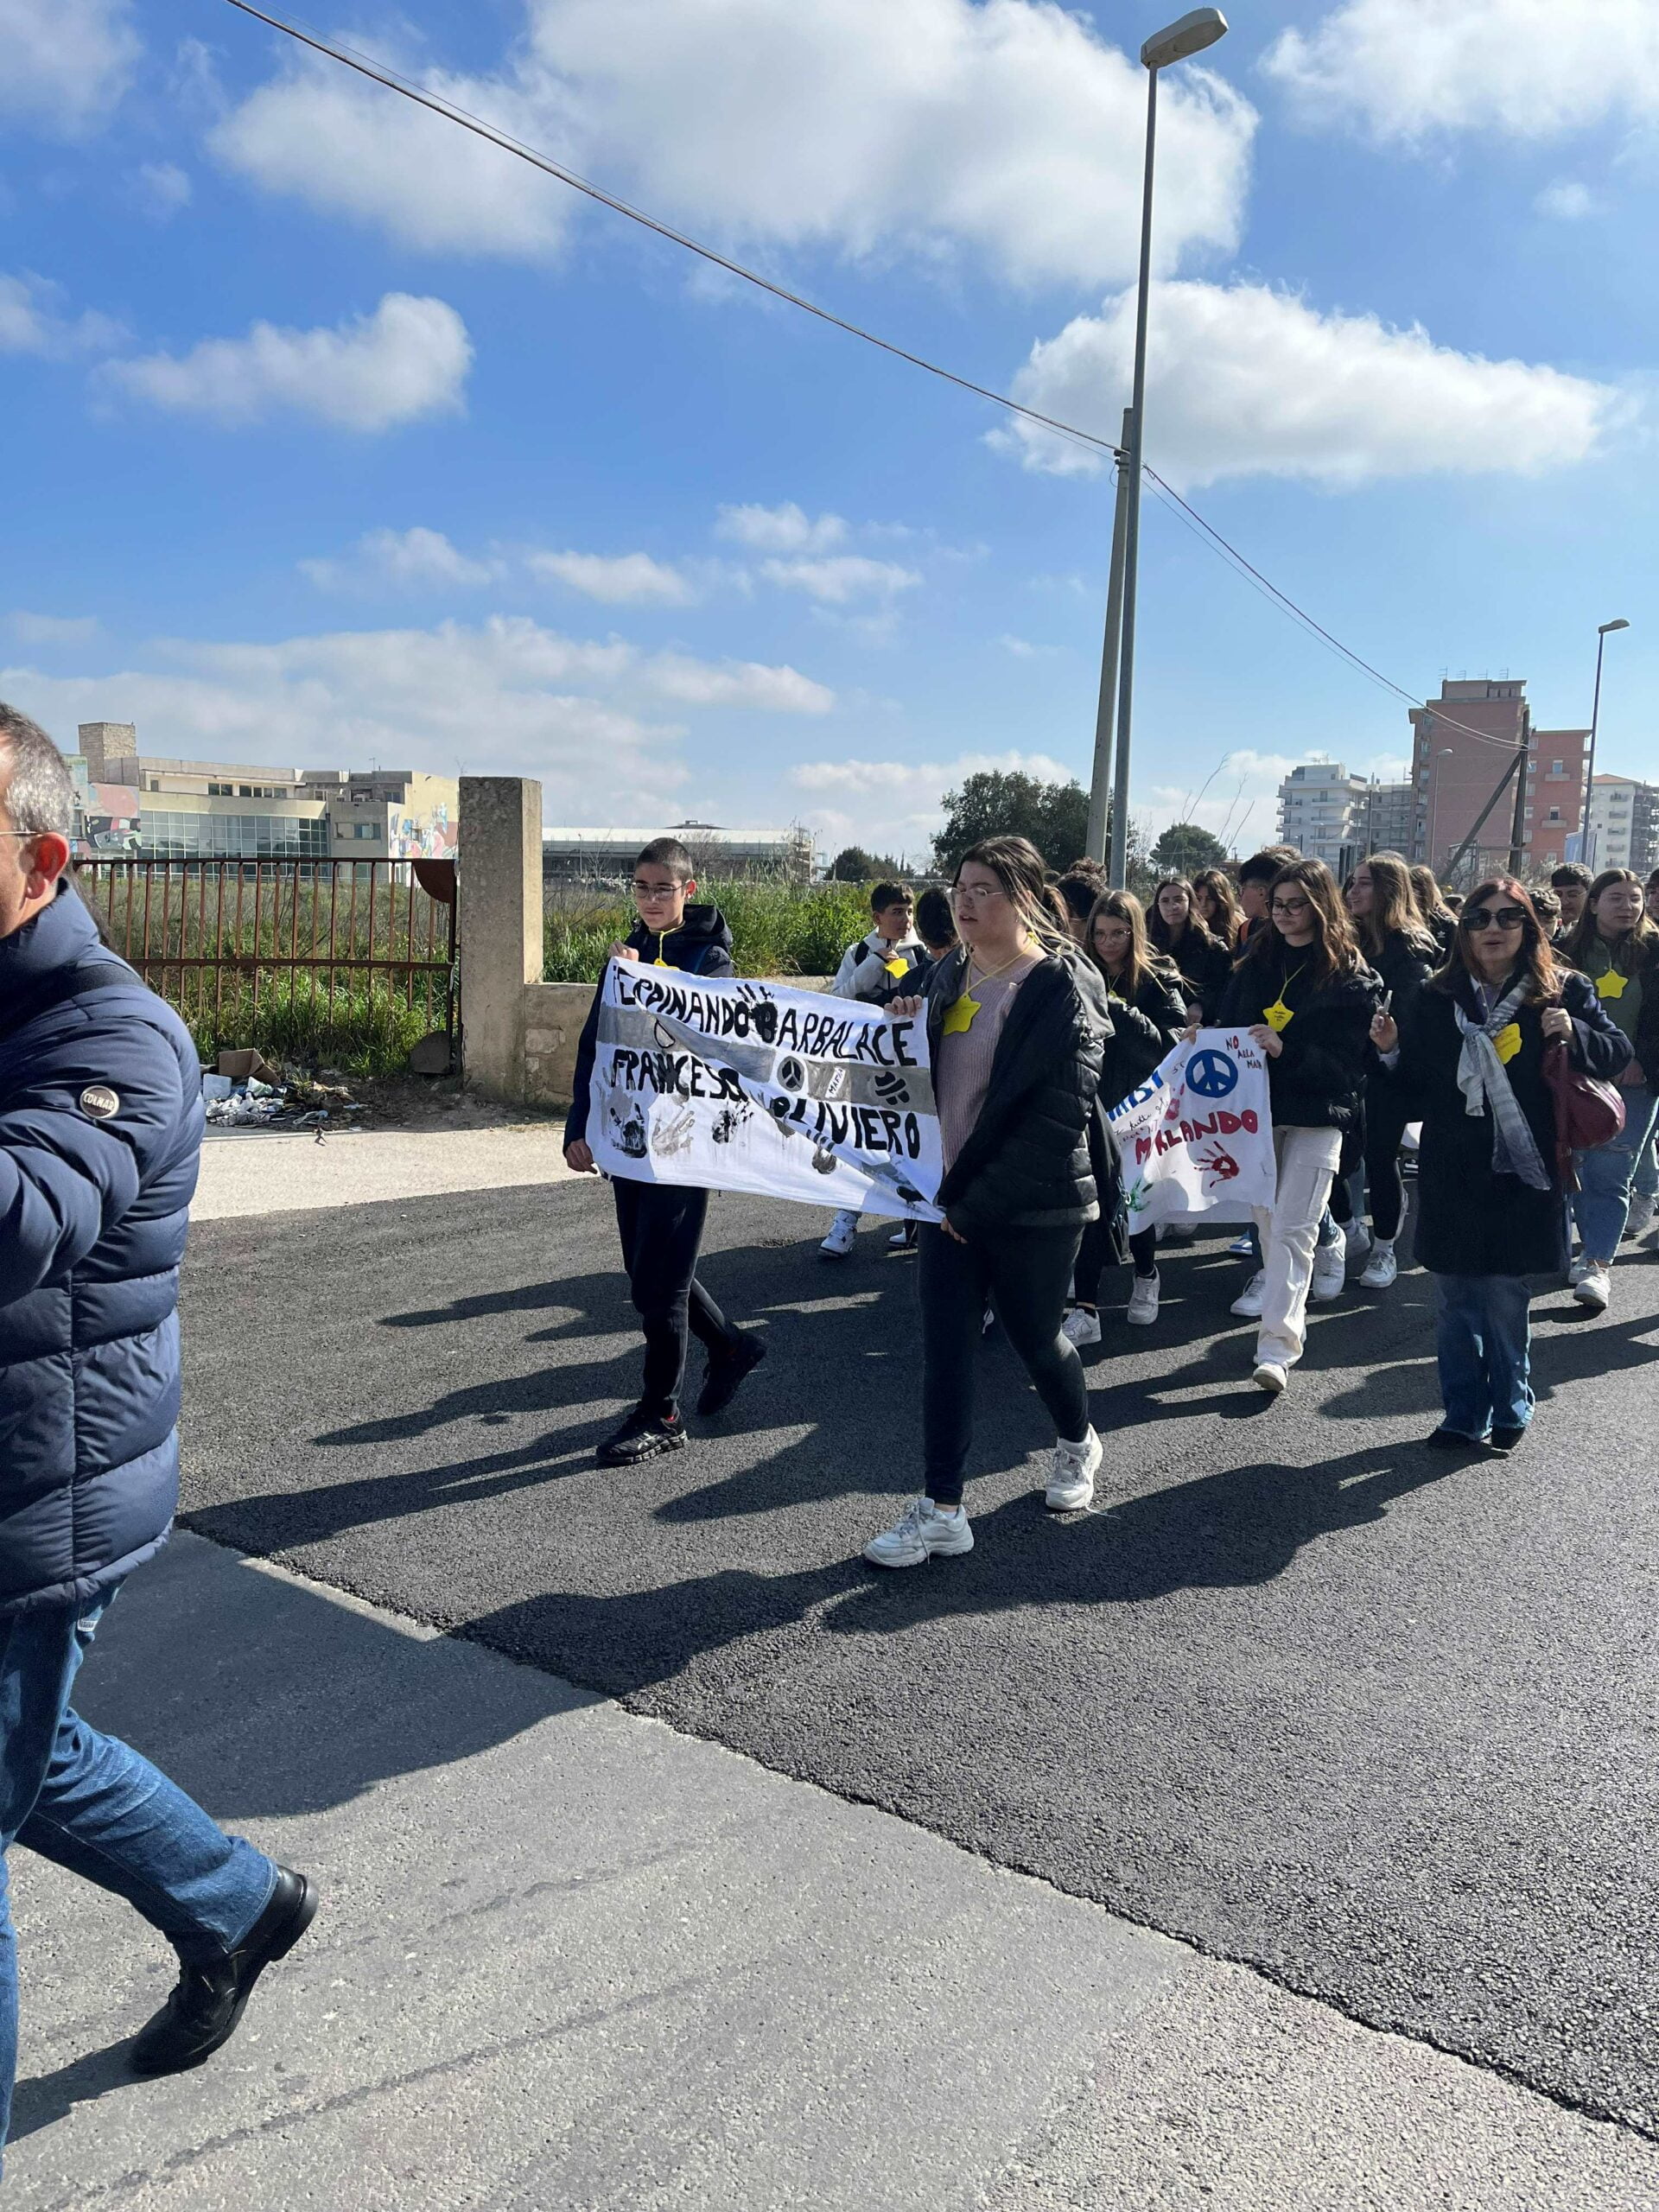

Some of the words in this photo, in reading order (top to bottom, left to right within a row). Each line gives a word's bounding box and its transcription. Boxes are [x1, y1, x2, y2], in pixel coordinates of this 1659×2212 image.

[754, 1001, 918, 1066] BARBALACE
[1225, 1035, 1239, 1051] NO
[1237, 1048, 1255, 1059] ALLA
[83, 1092, 115, 1111] COLMAR
[772, 1096, 920, 1160] OLIVIERO
